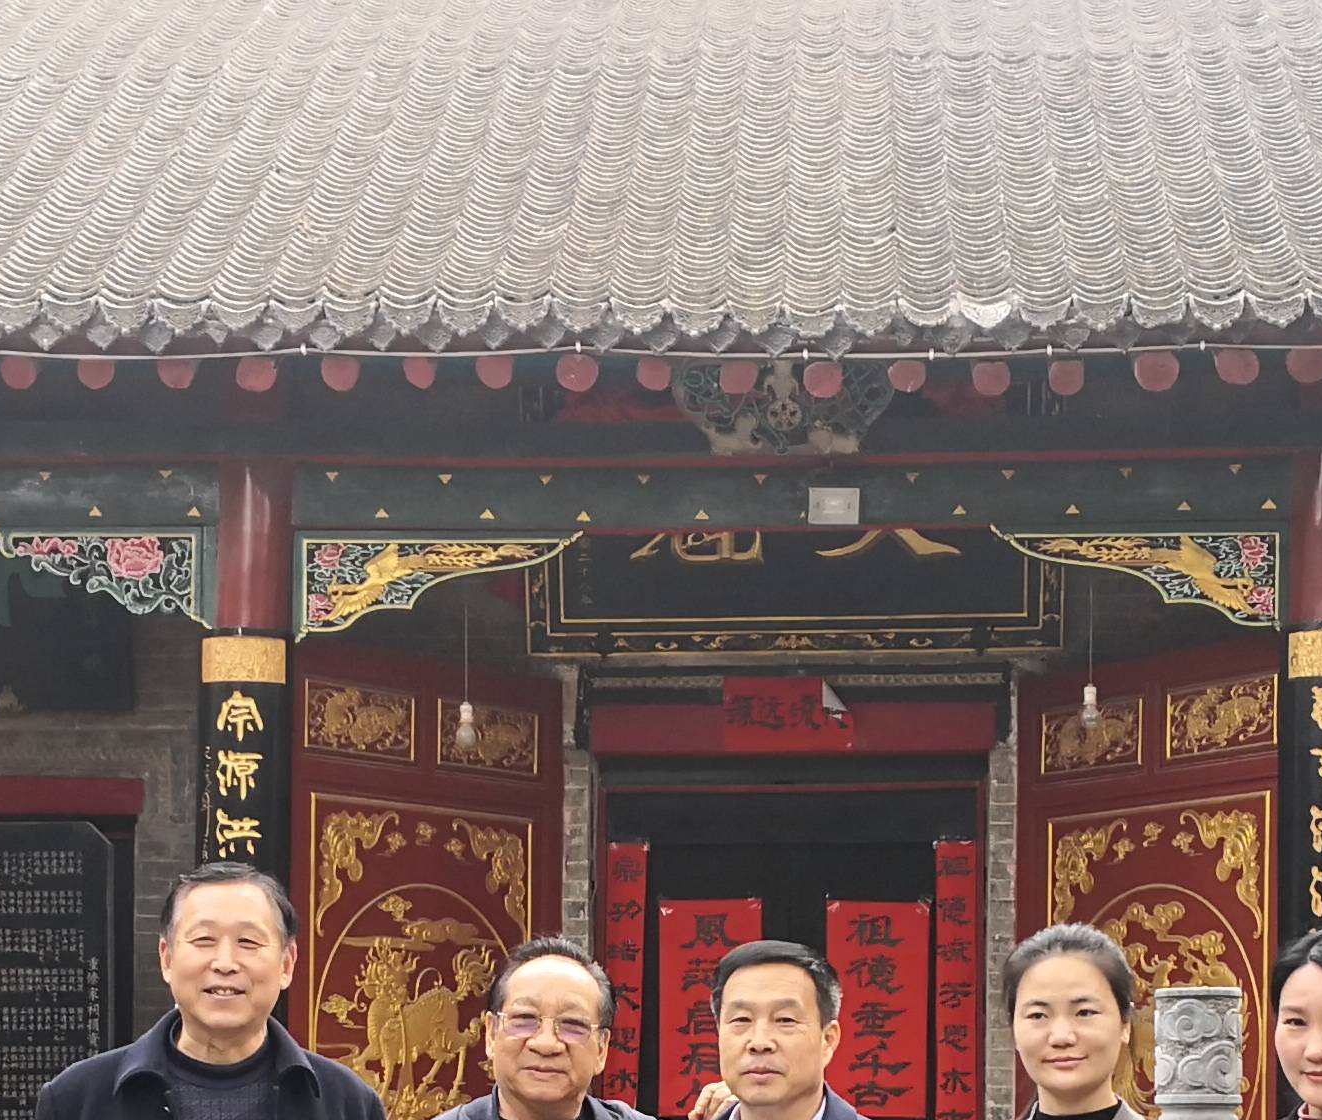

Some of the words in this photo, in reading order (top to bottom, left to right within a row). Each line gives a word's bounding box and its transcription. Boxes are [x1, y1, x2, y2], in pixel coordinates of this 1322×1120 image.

[845, 913, 912, 1110] 祖德垂千古
